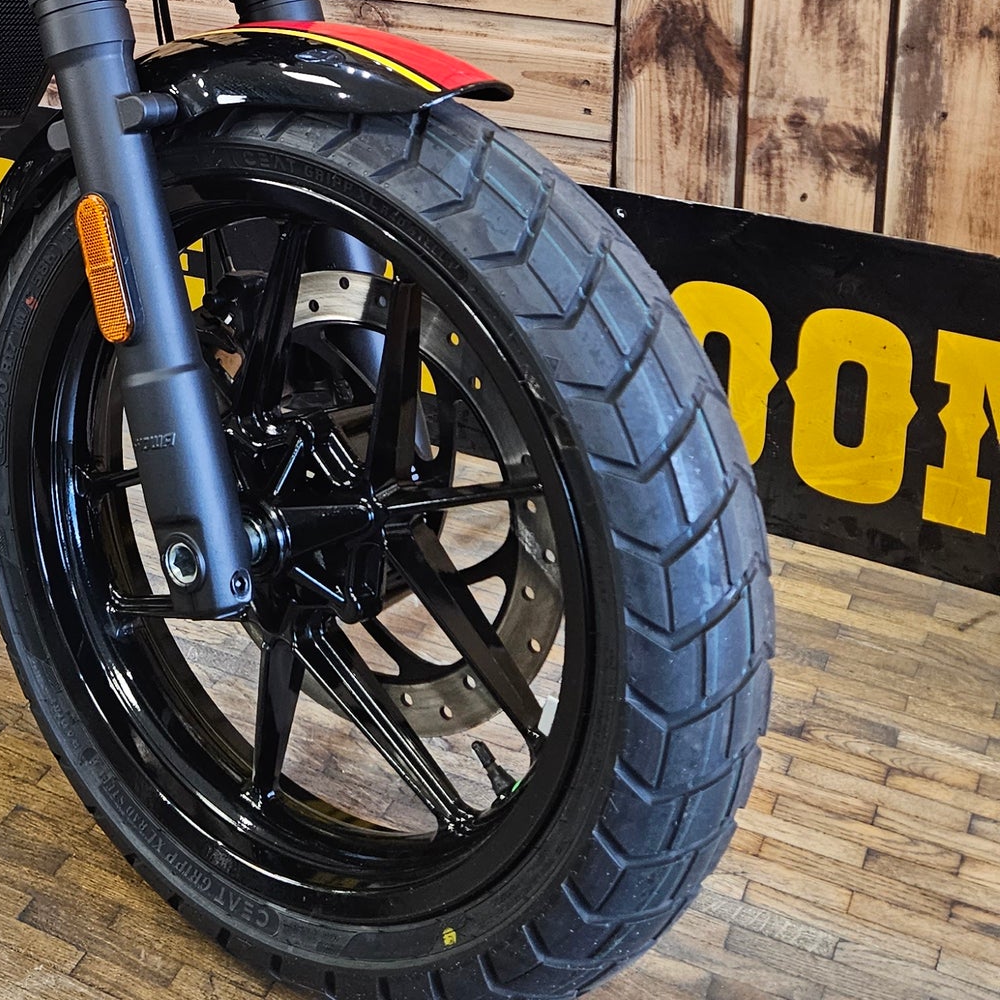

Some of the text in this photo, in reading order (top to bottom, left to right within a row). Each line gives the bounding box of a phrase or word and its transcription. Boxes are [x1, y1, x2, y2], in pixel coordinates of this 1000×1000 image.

[146, 830, 166, 853] XL
[165, 852, 213, 892] GRIPP
[214, 886, 270, 929] CEAT
